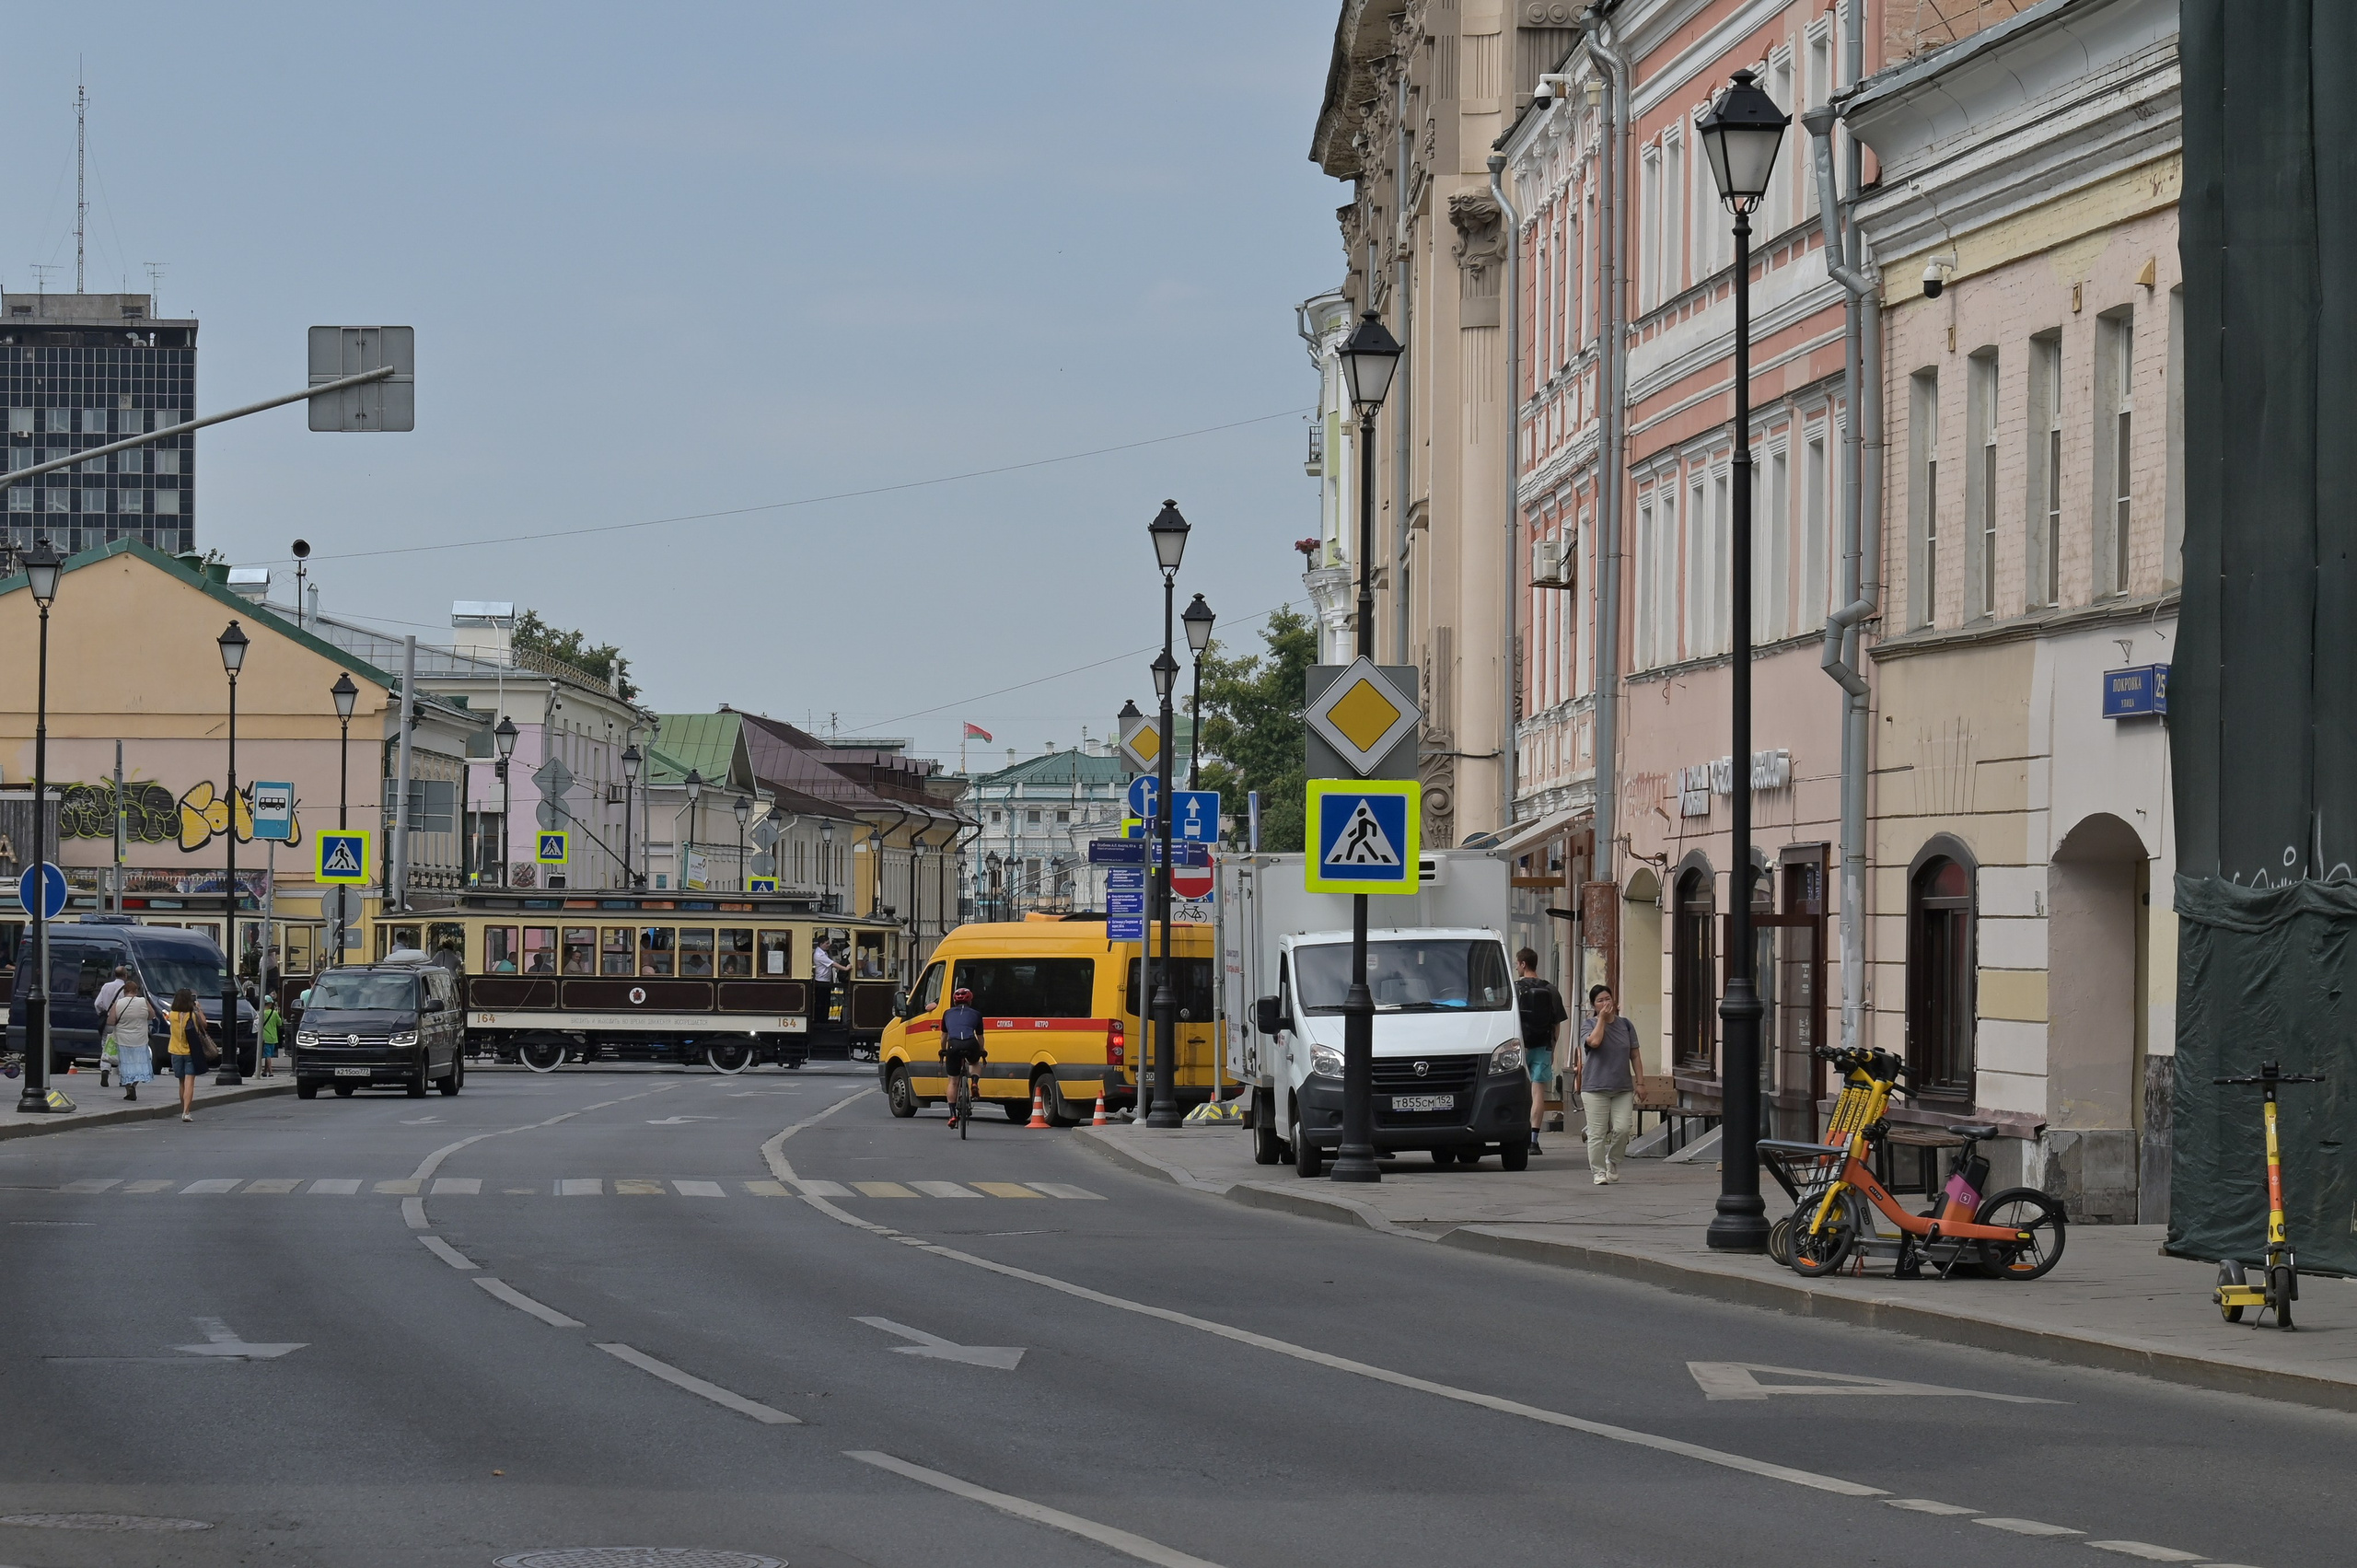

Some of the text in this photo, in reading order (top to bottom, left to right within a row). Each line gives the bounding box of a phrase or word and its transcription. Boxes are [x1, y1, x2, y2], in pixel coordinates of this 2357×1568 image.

[2113, 676, 2142, 692] ПОКРОВКА
[2155, 673, 2166, 699] 25
[2120, 699, 2135, 708] УЛИЦА
[477, 1014, 496, 1024] 164
[778, 1018, 796, 1028] 164
[1034, 1020, 1050, 1028] МЕТРО
[1436, 1096, 1452, 1104] 152
[1830, 1090, 1848, 1129] WHOOSH
[1842, 1090, 1859, 1129] WHOOSH
[1852, 1091, 1868, 1132] WHOOSH
